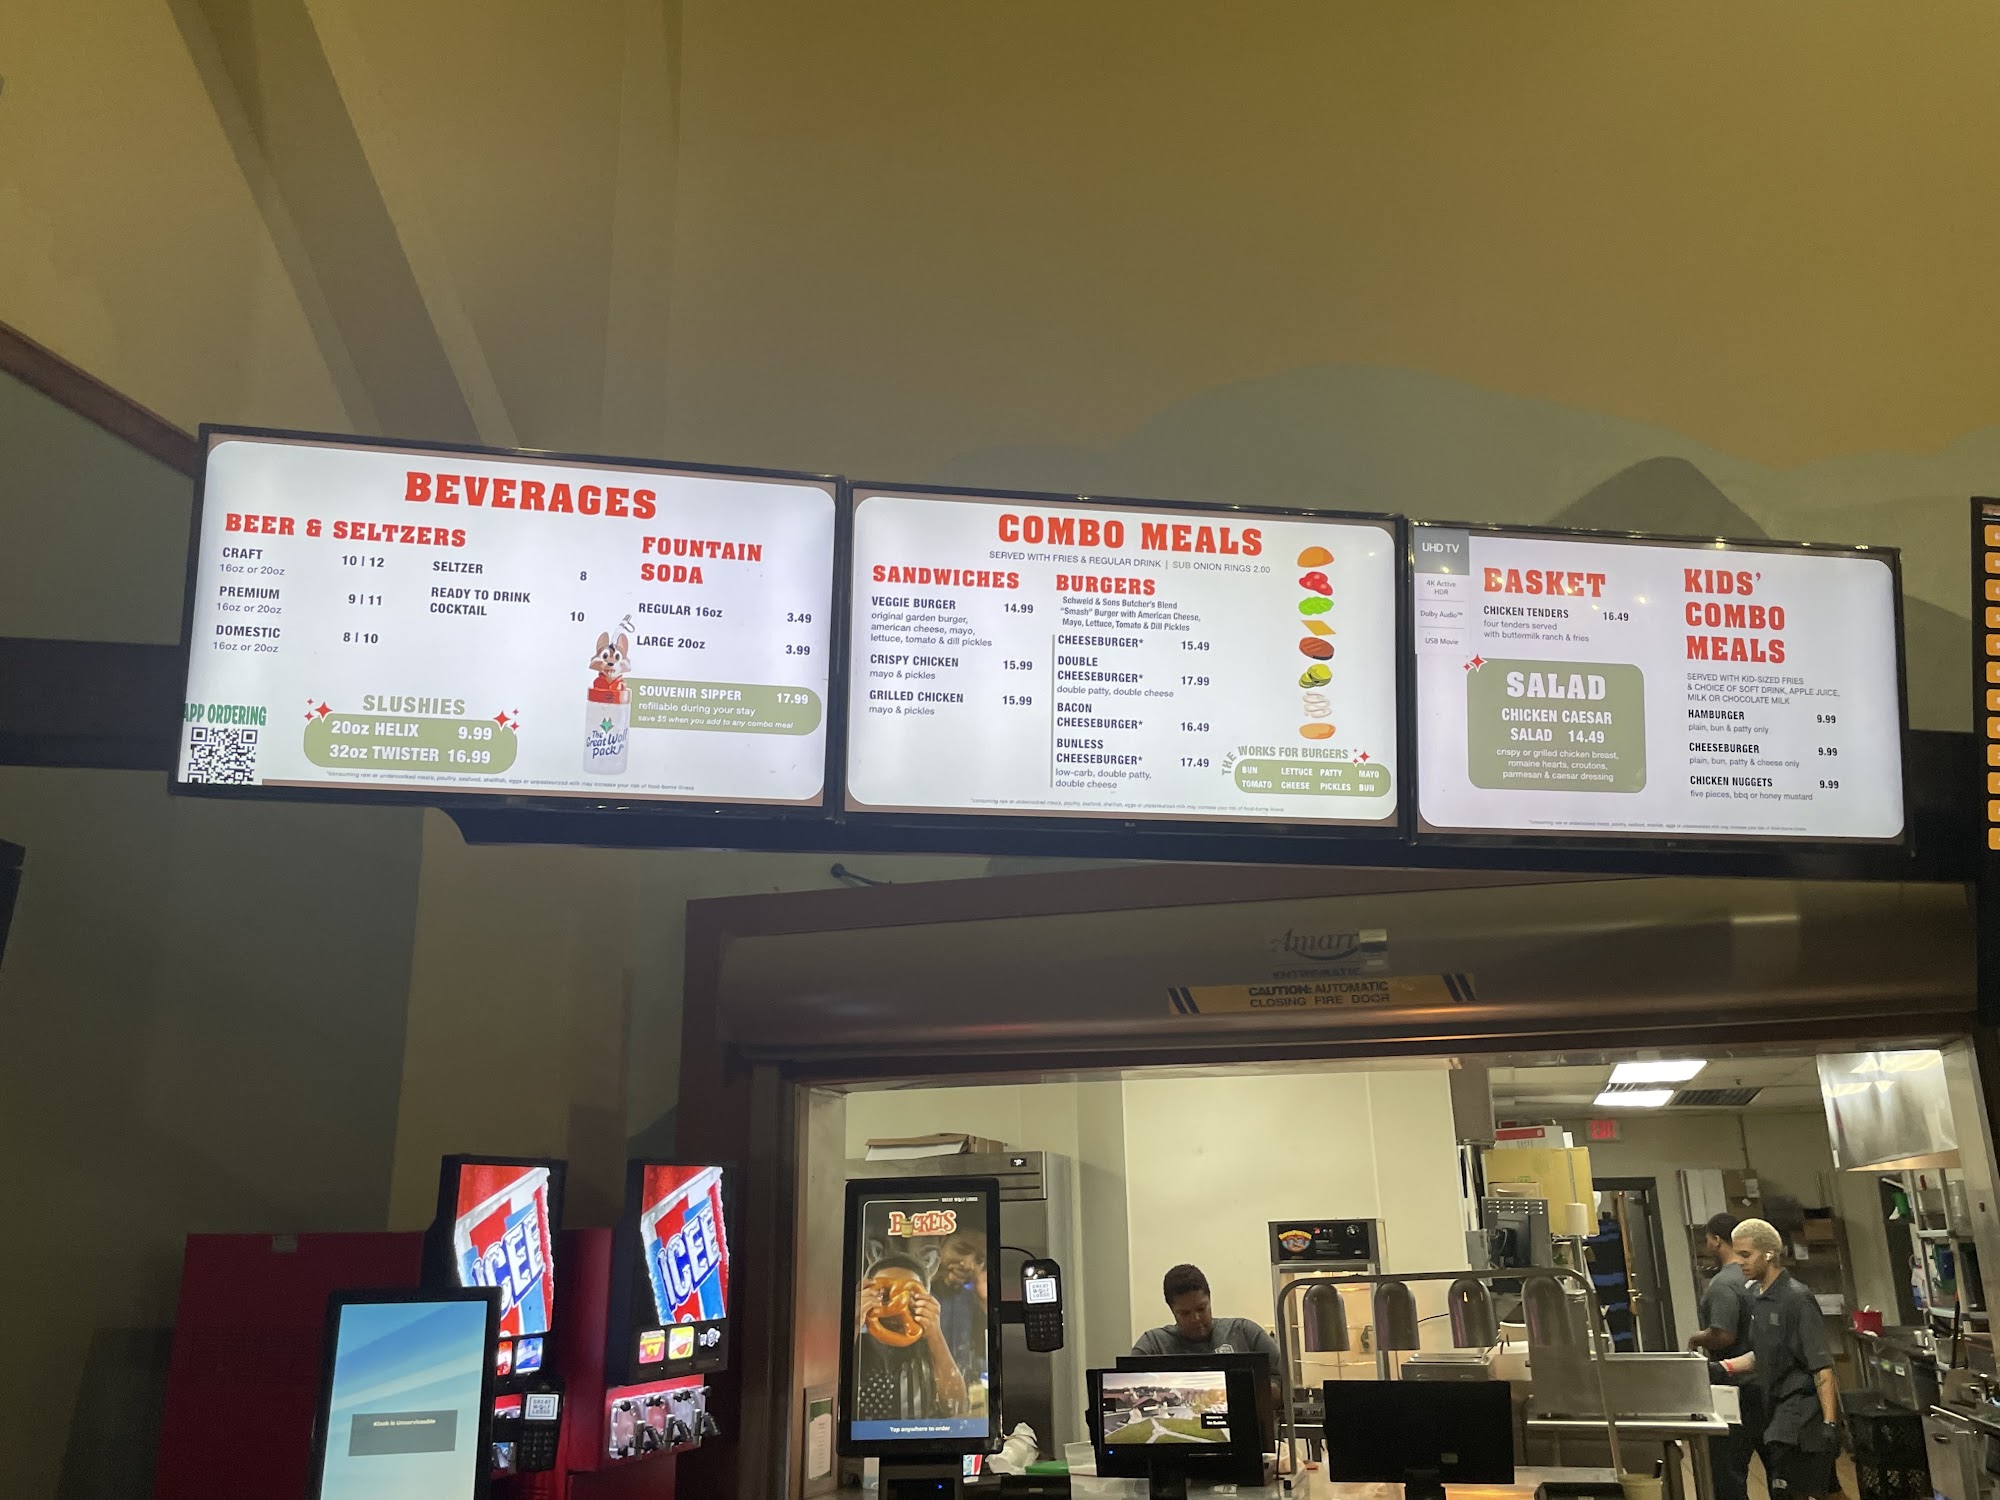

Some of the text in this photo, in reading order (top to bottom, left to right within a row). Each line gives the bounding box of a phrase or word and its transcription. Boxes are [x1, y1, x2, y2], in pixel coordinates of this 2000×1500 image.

[404, 471, 656, 519] BEVERAGES
[225, 512, 466, 547] BEER & SELTZERS
[998, 513, 1262, 556] COMBO MEALS
[222, 546, 263, 560] CRAFT
[641, 536, 762, 562] FOUNTAIN
[1421, 542, 1460, 553] UHD TV
[342, 554, 384, 568] 10 12
[989, 550, 1271, 574] SERVED WITH FRIES & REGULAR DRINK SUB ONION RINGS 2.00
[219, 563, 285, 576] 16oz or 20oz
[432, 560, 587, 581] SELTZER 8
[640, 562, 703, 584] SODA
[872, 564, 1019, 589] SANDWICHES
[1055, 574, 1155, 596] BURGERS
[1483, 567, 1606, 598] BASKET
[219, 585, 279, 599] PREMIUM
[348, 593, 382, 606] 9 11
[431, 586, 530, 603] READY TO DRINK
[216, 602, 241, 612] 16oz
[257, 604, 282, 614] 20oz
[429, 602, 585, 622] COCKTAIL 10
[638, 602, 812, 623] REGULAR 16oz 3.49
[871, 595, 1033, 614] VEGGIE BURGER 14.99
[1483, 605, 1629, 622] CHICKEN TENDERS 16.49
[1685, 601, 1785, 631] COMBO
[215, 624, 280, 638] DOMESTIC
[1483, 619, 1558, 631] four tenders served
[343, 631, 378, 644] 8 10
[1483, 630, 1589, 642] with buttermilk ranch & fries
[636, 635, 810, 656] LARGE 20oz 3.99
[1181, 640, 1210, 651] 15.49
[1686, 635, 1785, 664] MEALS
[870, 653, 1033, 671] CRISPY CHICKEN 15.99
[1057, 655, 1098, 667] DOUBLE
[869, 669, 936, 680] mayo & pickles
[1181, 675, 1209, 686] 17.99
[1056, 684, 1174, 698] double patty, double cheese
[1506, 671, 1606, 700] SALAD
[639, 685, 808, 704] SOUVENIR SIPPER 17.99
[869, 689, 1032, 706] GRILLED CHICKEN 15.99
[362, 694, 465, 715] SLUSHIES
[638, 701, 756, 717] refillable during your stay
[868, 705, 935, 716] mayo & pickles
[1057, 702, 1092, 713] BACON
[207, 703, 266, 726] ORDERING
[1501, 707, 1612, 725] CHICKEN CAESAR
[1688, 709, 1836, 724] HAMBURGER 9.99
[330, 720, 492, 740] 20oz HELIX 9.99
[592, 730, 603, 738] The
[1180, 721, 1209, 732] 16.49
[1510, 727, 1604, 743] SALAD 14.49
[1056, 738, 1104, 749] BUNLESS
[1689, 742, 1838, 756] CHEESEBURGER 9.99
[329, 744, 491, 764] 32oz TWISTER 16.99
[1222, 745, 1349, 775] THE WORKS FOR BURGERS
[1180, 757, 1209, 768] 17.49
[1241, 765, 1379, 778] BUN LETTUCE PATTY MAYO
[1241, 779, 1374, 792] TOMATO CHEESE PICKLES BUN
[1690, 775, 1839, 789] CHICKEN NUGGETS 9.99
[1249, 981, 1388, 996] CAUTION: AUTOMATIC
[1250, 993, 1390, 1007] CLOSING FIRE DOOR
[657, 1208, 721, 1313] ICEE
